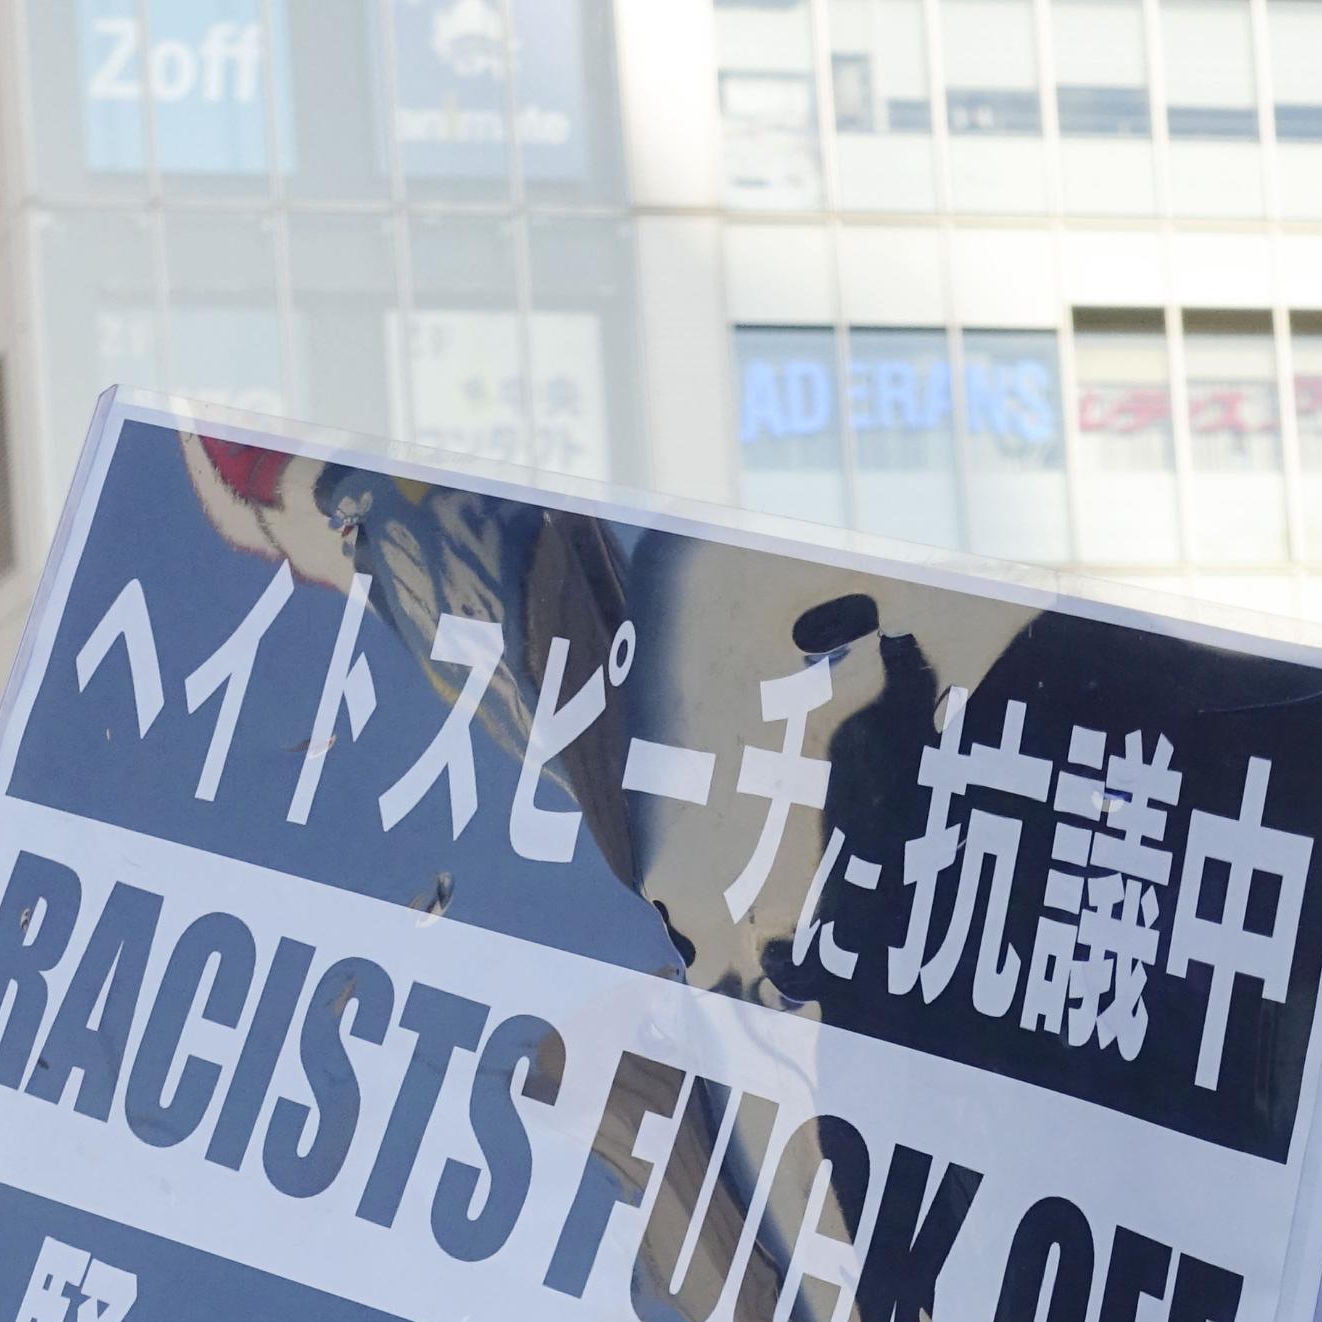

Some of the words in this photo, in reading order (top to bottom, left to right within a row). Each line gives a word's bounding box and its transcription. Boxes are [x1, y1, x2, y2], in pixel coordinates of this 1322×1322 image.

[88, 18, 264, 104] Zoff
[394, 88, 571, 145] animate
[739, 353, 1057, 446] ADERANS
[75, 558, 1314, 1092] ヘイトスピーチに抗議中
